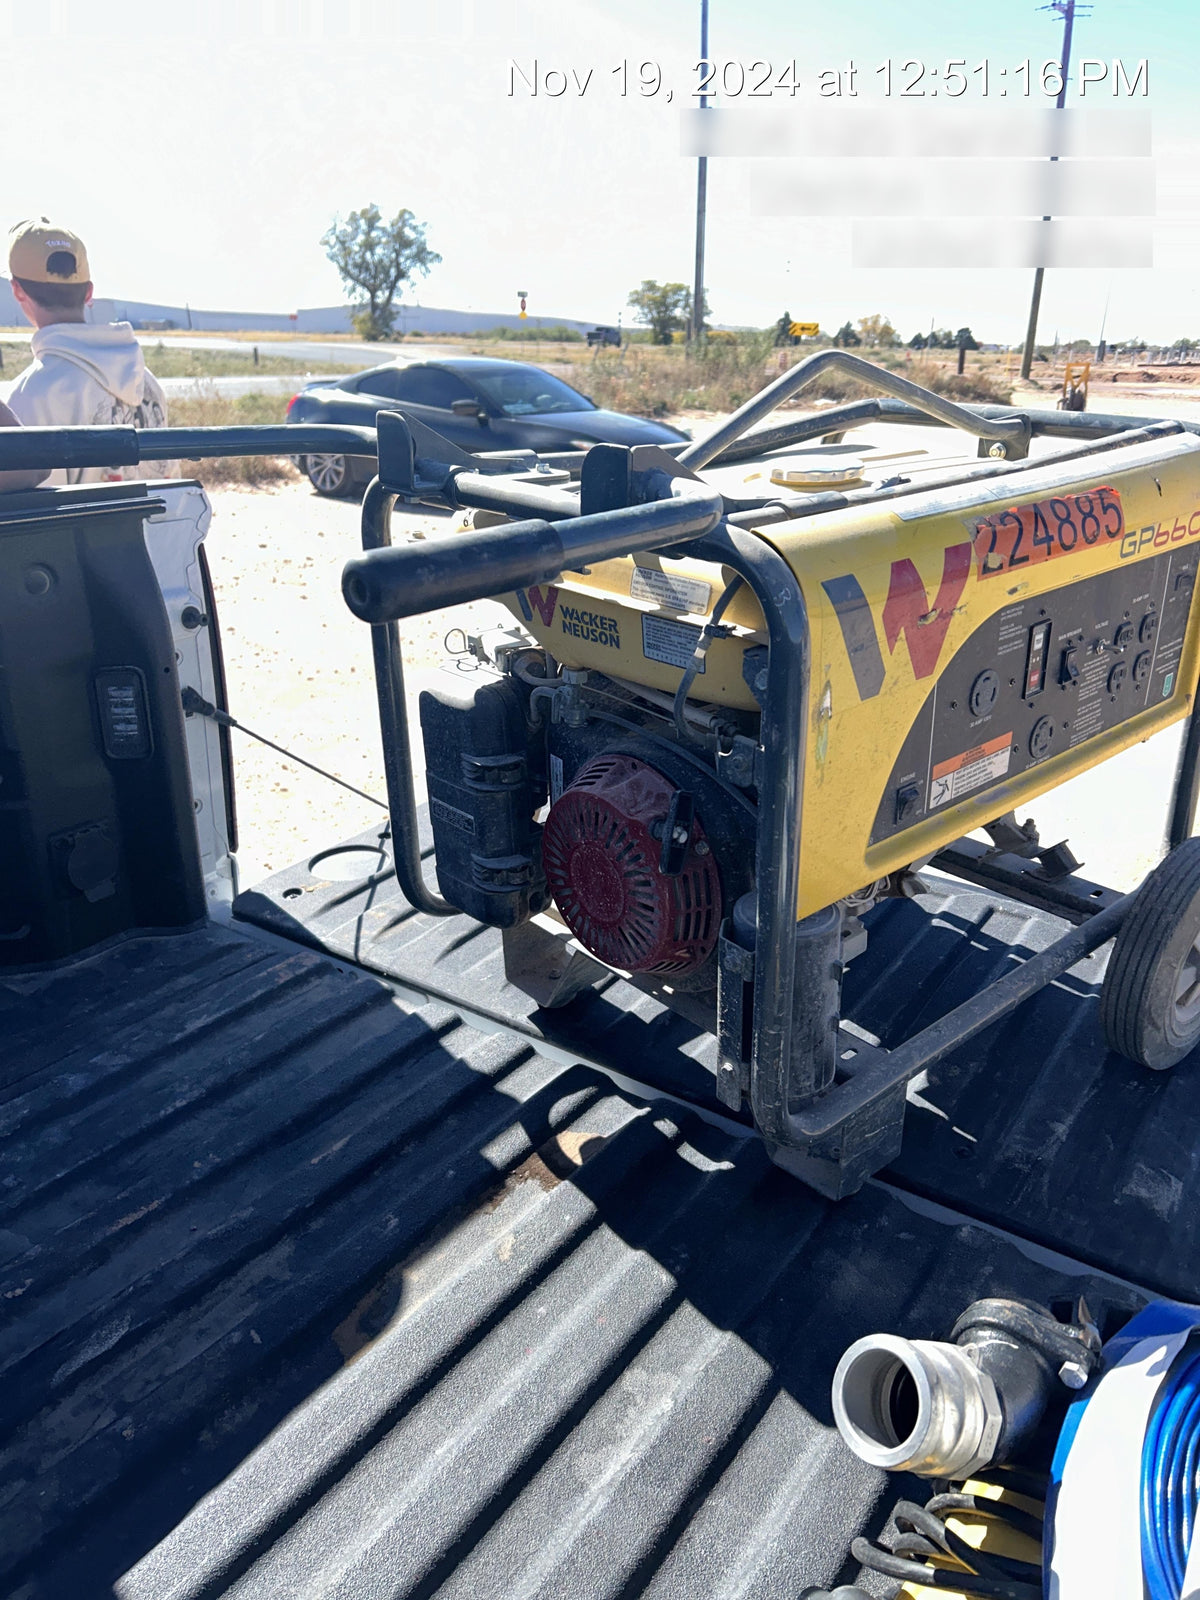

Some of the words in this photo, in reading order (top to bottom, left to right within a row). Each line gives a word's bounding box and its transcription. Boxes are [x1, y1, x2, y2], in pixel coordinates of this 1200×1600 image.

[979, 489, 1122, 576] 224885
[559, 604, 618, 634] WACKER
[562, 621, 620, 650] NEUSON
